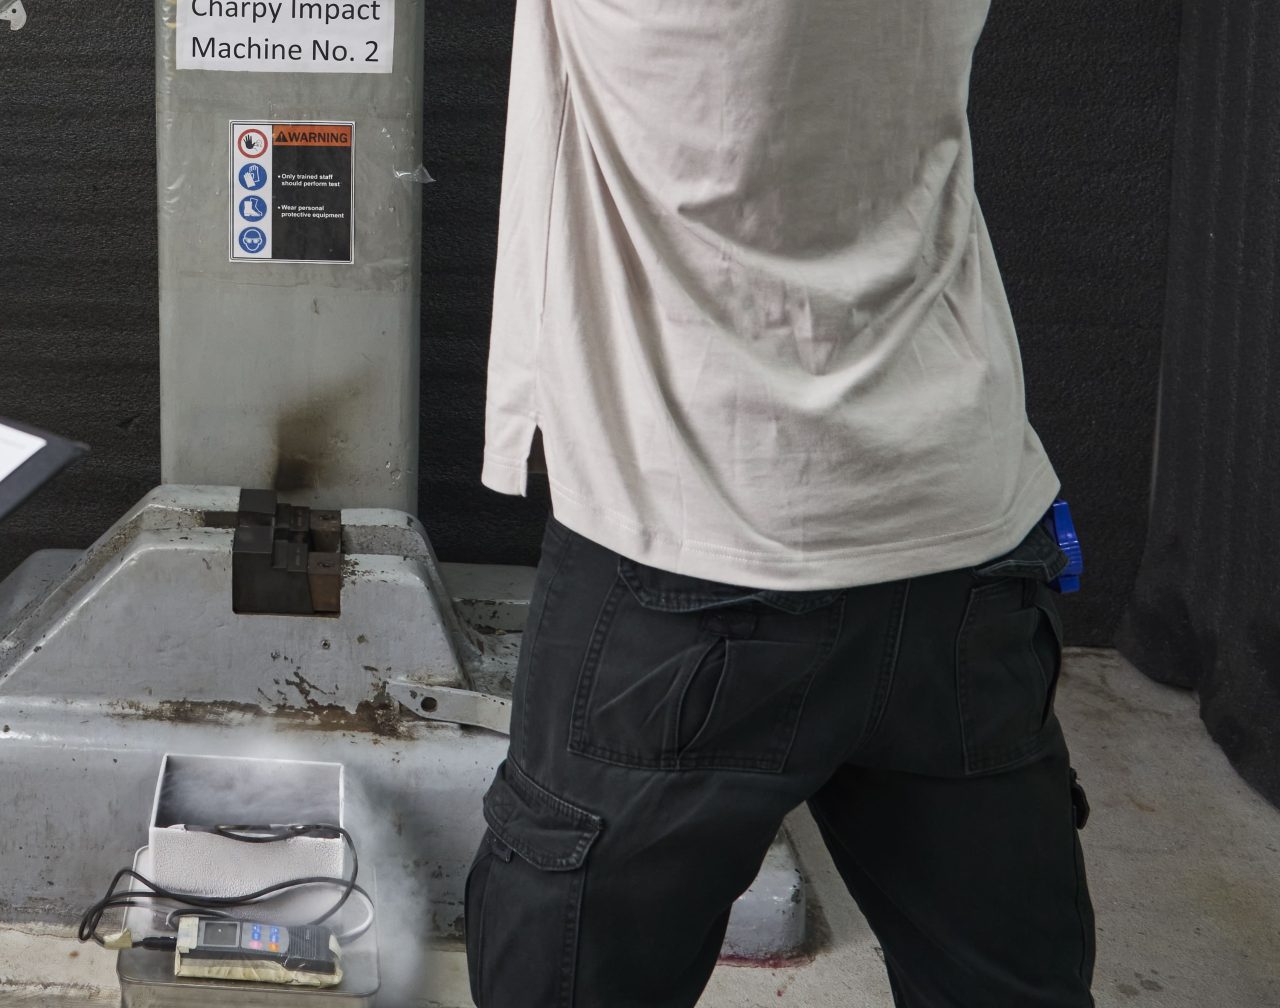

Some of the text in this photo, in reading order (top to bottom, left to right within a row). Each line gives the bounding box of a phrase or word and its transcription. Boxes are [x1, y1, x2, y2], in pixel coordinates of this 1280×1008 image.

[192, 37, 379, 62] Machine No. 2
[288, 132, 348, 143] WARNING
